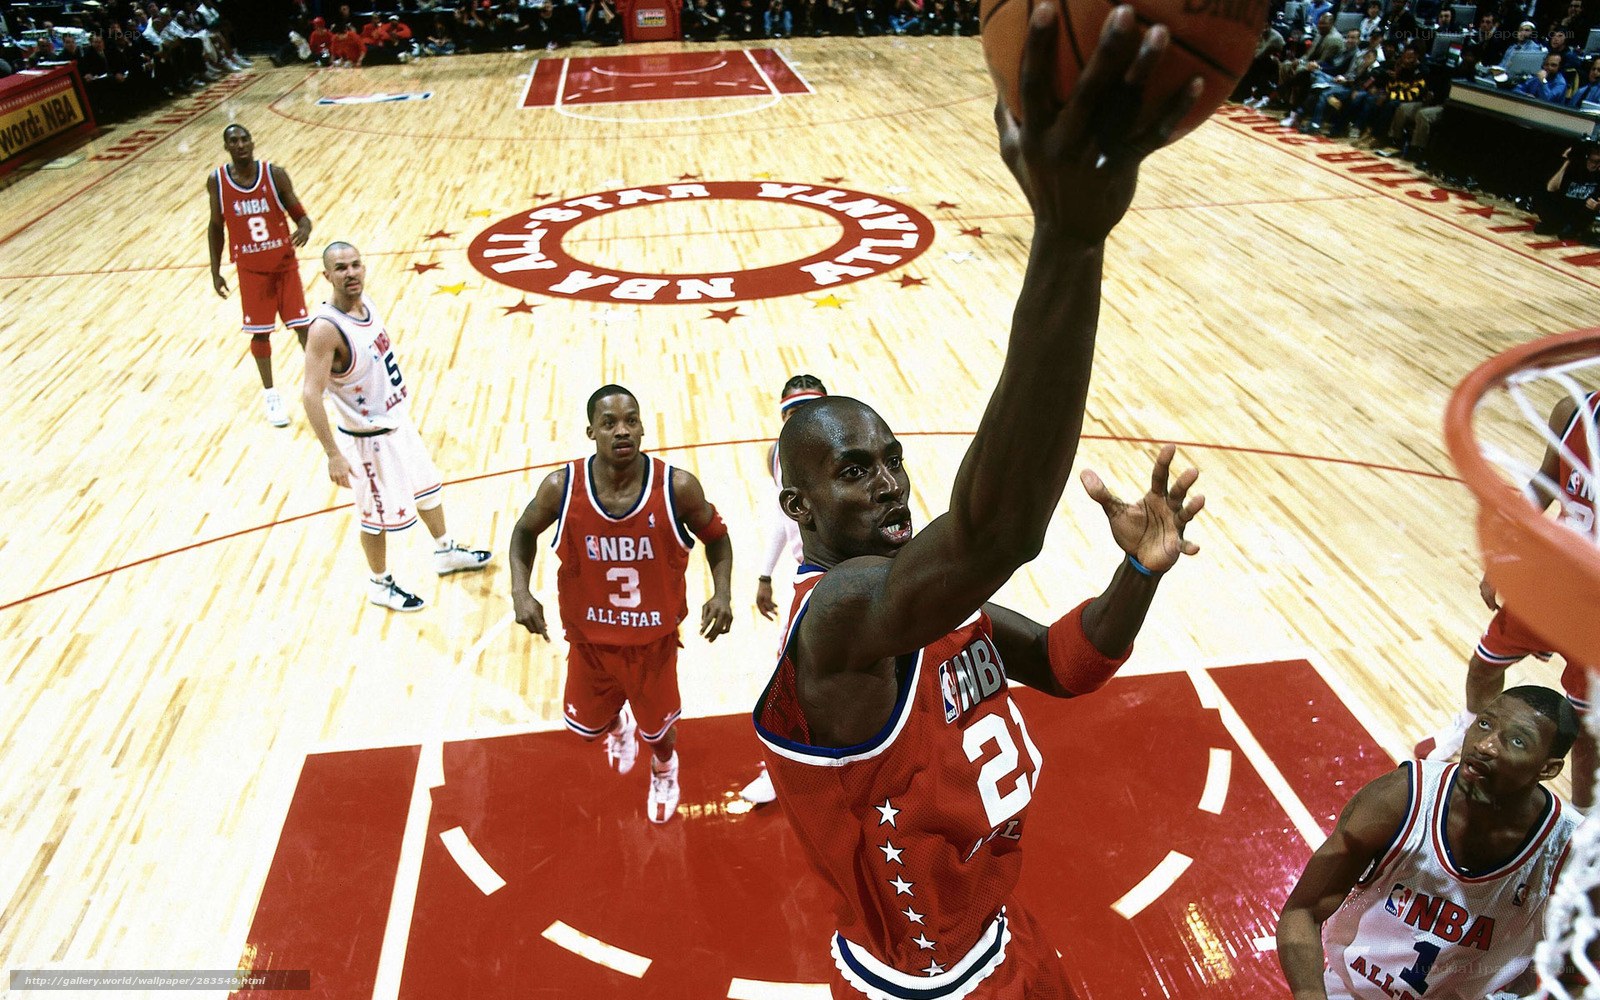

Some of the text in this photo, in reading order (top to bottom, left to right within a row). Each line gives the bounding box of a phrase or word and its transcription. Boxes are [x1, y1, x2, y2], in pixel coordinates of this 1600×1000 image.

[41, 94, 78, 132] NBA
[241, 197, 271, 216] NBA
[247, 216, 270, 243] 8
[549, 269, 736, 301] NBA
[756, 182, 920, 287] ATLANTA
[384, 351, 403, 387] 5
[363, 462, 385, 524] EAST
[600, 535, 655, 562] NBA
[606, 567, 642, 609] 3
[952, 638, 1009, 713] NB
[961, 694, 1044, 830] 21
[1404, 893, 1496, 951] NBA
[1398, 939, 1442, 996] 1
